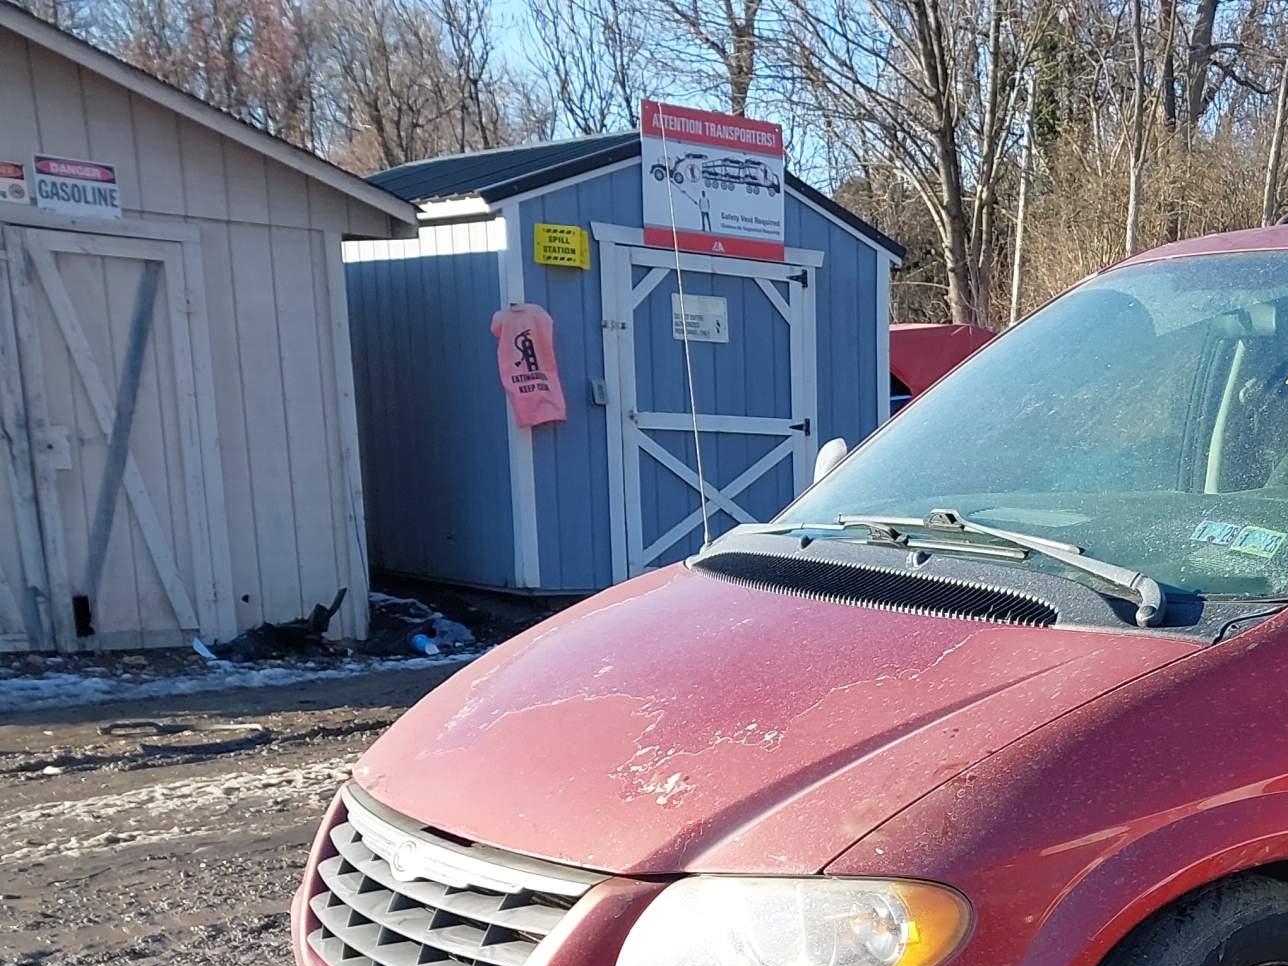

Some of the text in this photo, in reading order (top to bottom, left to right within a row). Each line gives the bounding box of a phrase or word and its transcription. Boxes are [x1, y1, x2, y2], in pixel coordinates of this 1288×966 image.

[652, 113, 776, 147] ATTENTION TRANSPORTERS!
[49, 161, 101, 180] DANGER
[38, 179, 119, 208] GASOLINE
[548, 235, 570, 244] SPILL
[543, 245, 576, 255] STATION
[519, 384, 536, 394] KEEP
